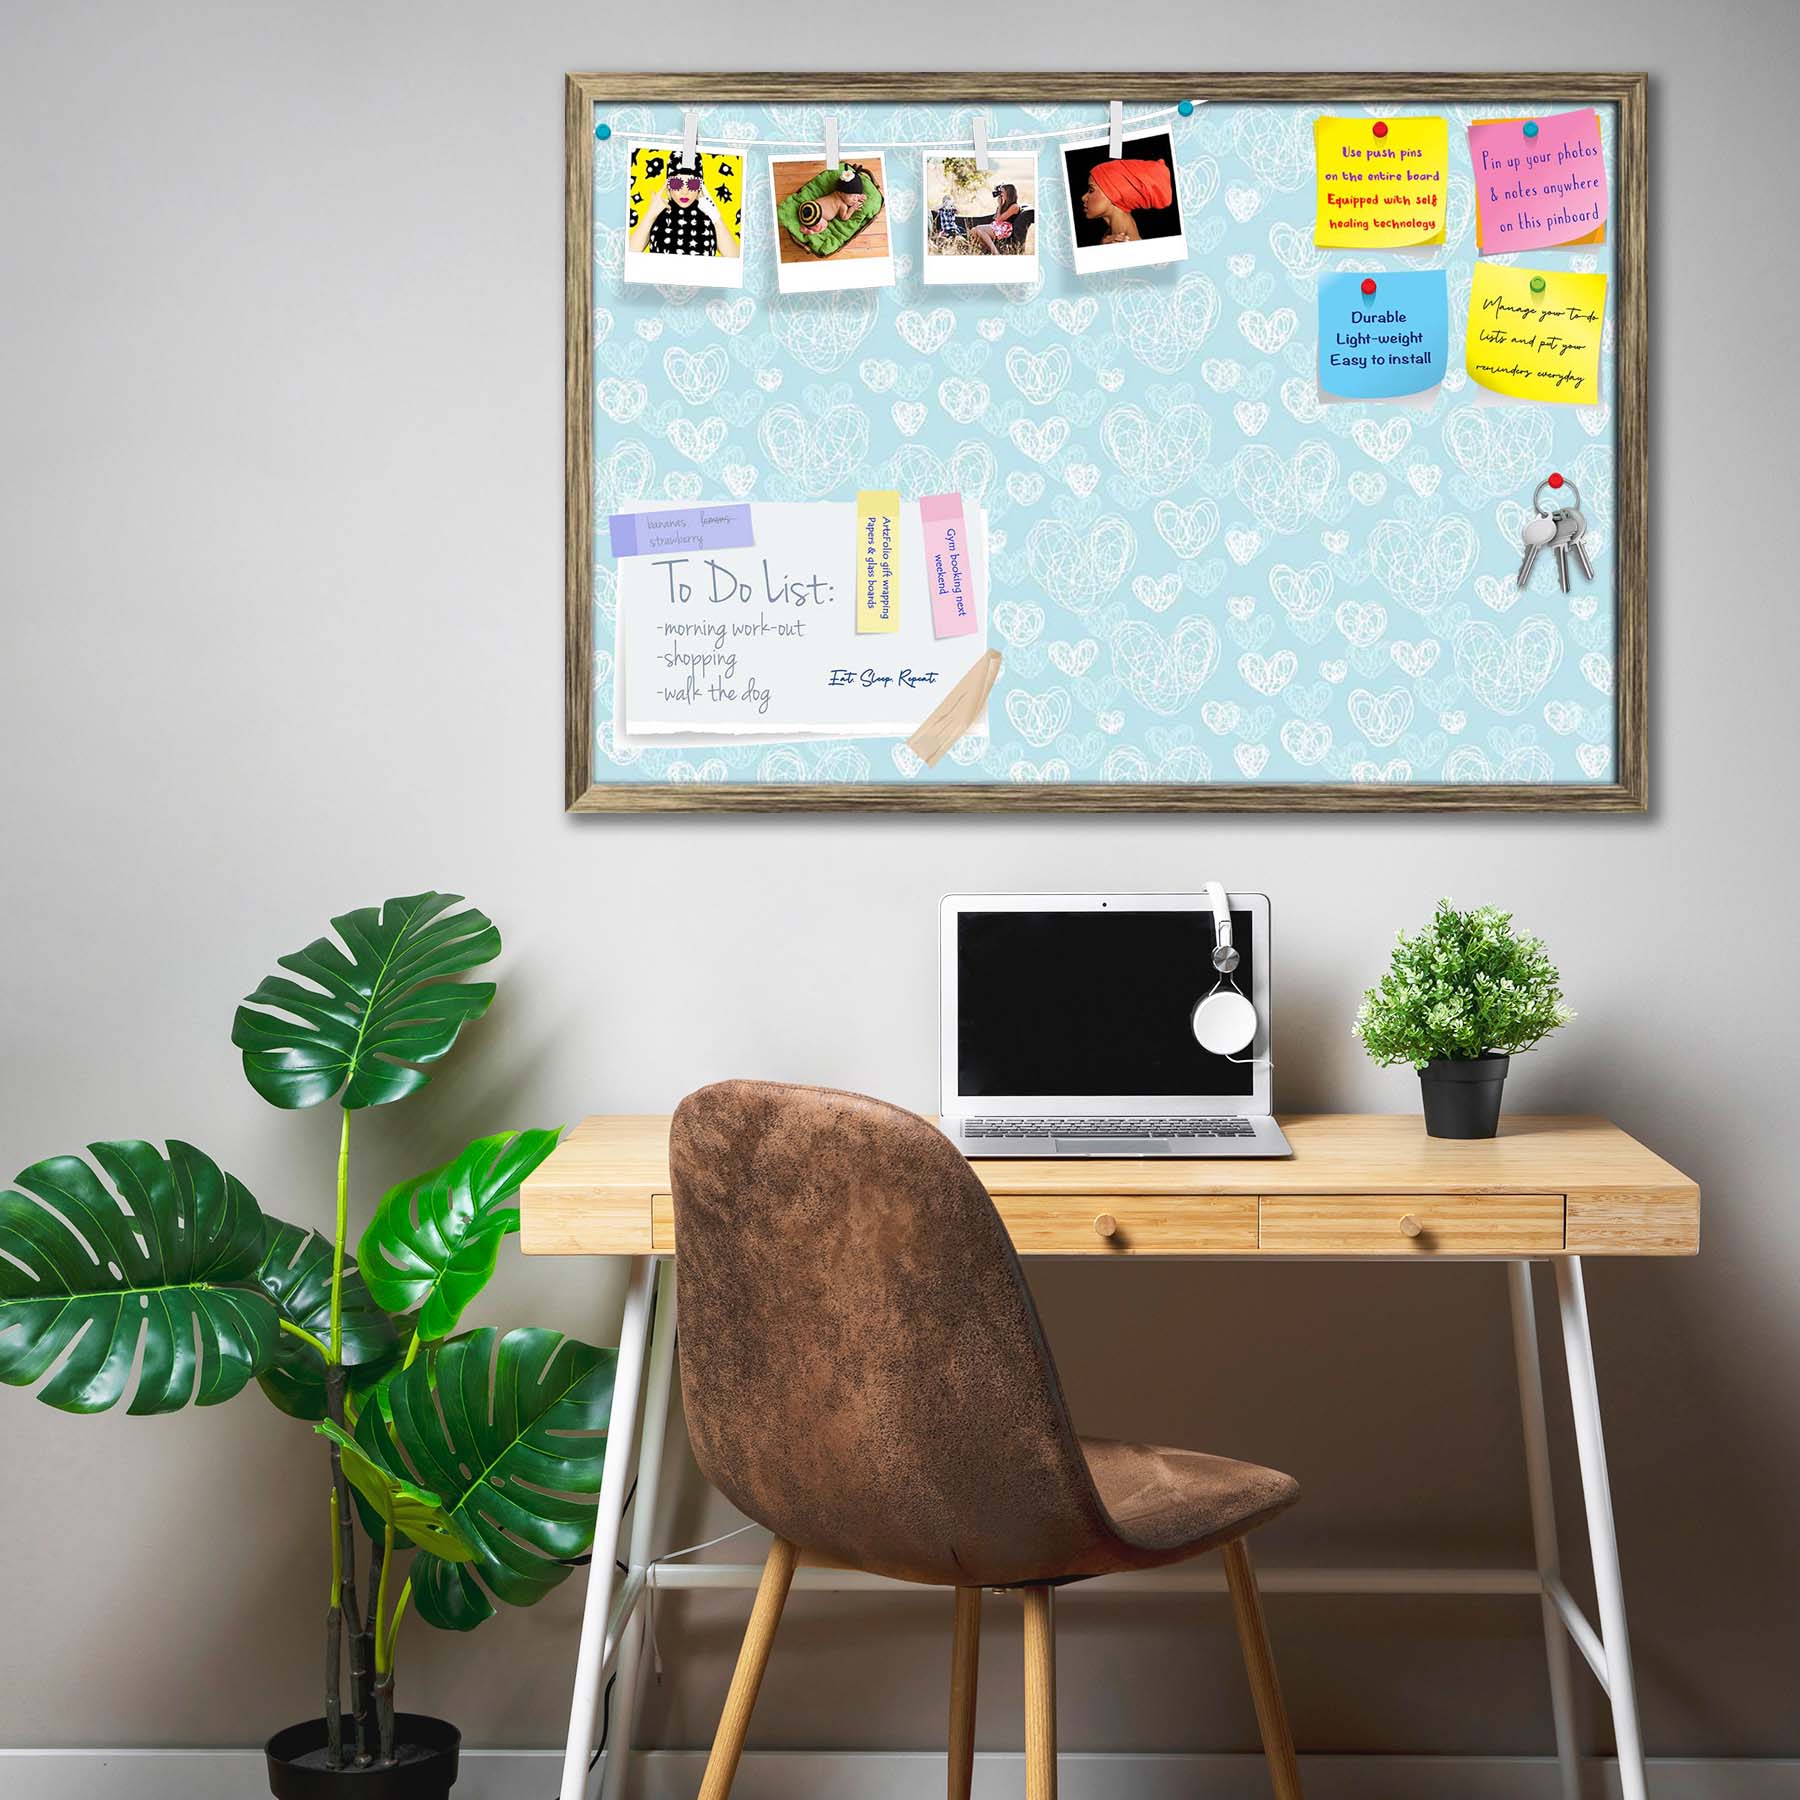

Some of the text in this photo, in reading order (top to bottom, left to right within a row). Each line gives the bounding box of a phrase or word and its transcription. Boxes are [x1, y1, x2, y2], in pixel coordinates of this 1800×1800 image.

[1342, 146, 1422, 161] Use push pins
[1482, 141, 1598, 171] Pin up your photos
[1342, 171, 1363, 181] the
[1367, 171, 1402, 180] entire
[1407, 170, 1440, 181] board
[1490, 173, 1599, 202] & notes anywhere
[1327, 193, 1438, 208] Equipped with self
[1329, 218, 1436, 230] healing technology
[1500, 202, 1599, 232] on this pinboard
[1351, 310, 1407, 324] Durable
[1483, 295, 1537, 319] Manage
[1336, 331, 1423, 348] Light-weight
[1511, 335, 1536, 347] and
[1537, 336, 1563, 353] put
[1330, 352, 1431, 369] Easy to install
[865, 517, 878, 609] Papers & glass boards
[880, 516, 893, 619] ArtzFolio gift wrapping
[934, 553, 949, 595] weekend
[945, 528, 967, 617] Gym booking next
[651, 559, 835, 607] To Do List:
[732, 611, 807, 637] work-out
[708, 674, 737, 701] the
[741, 677, 771, 714] dog
